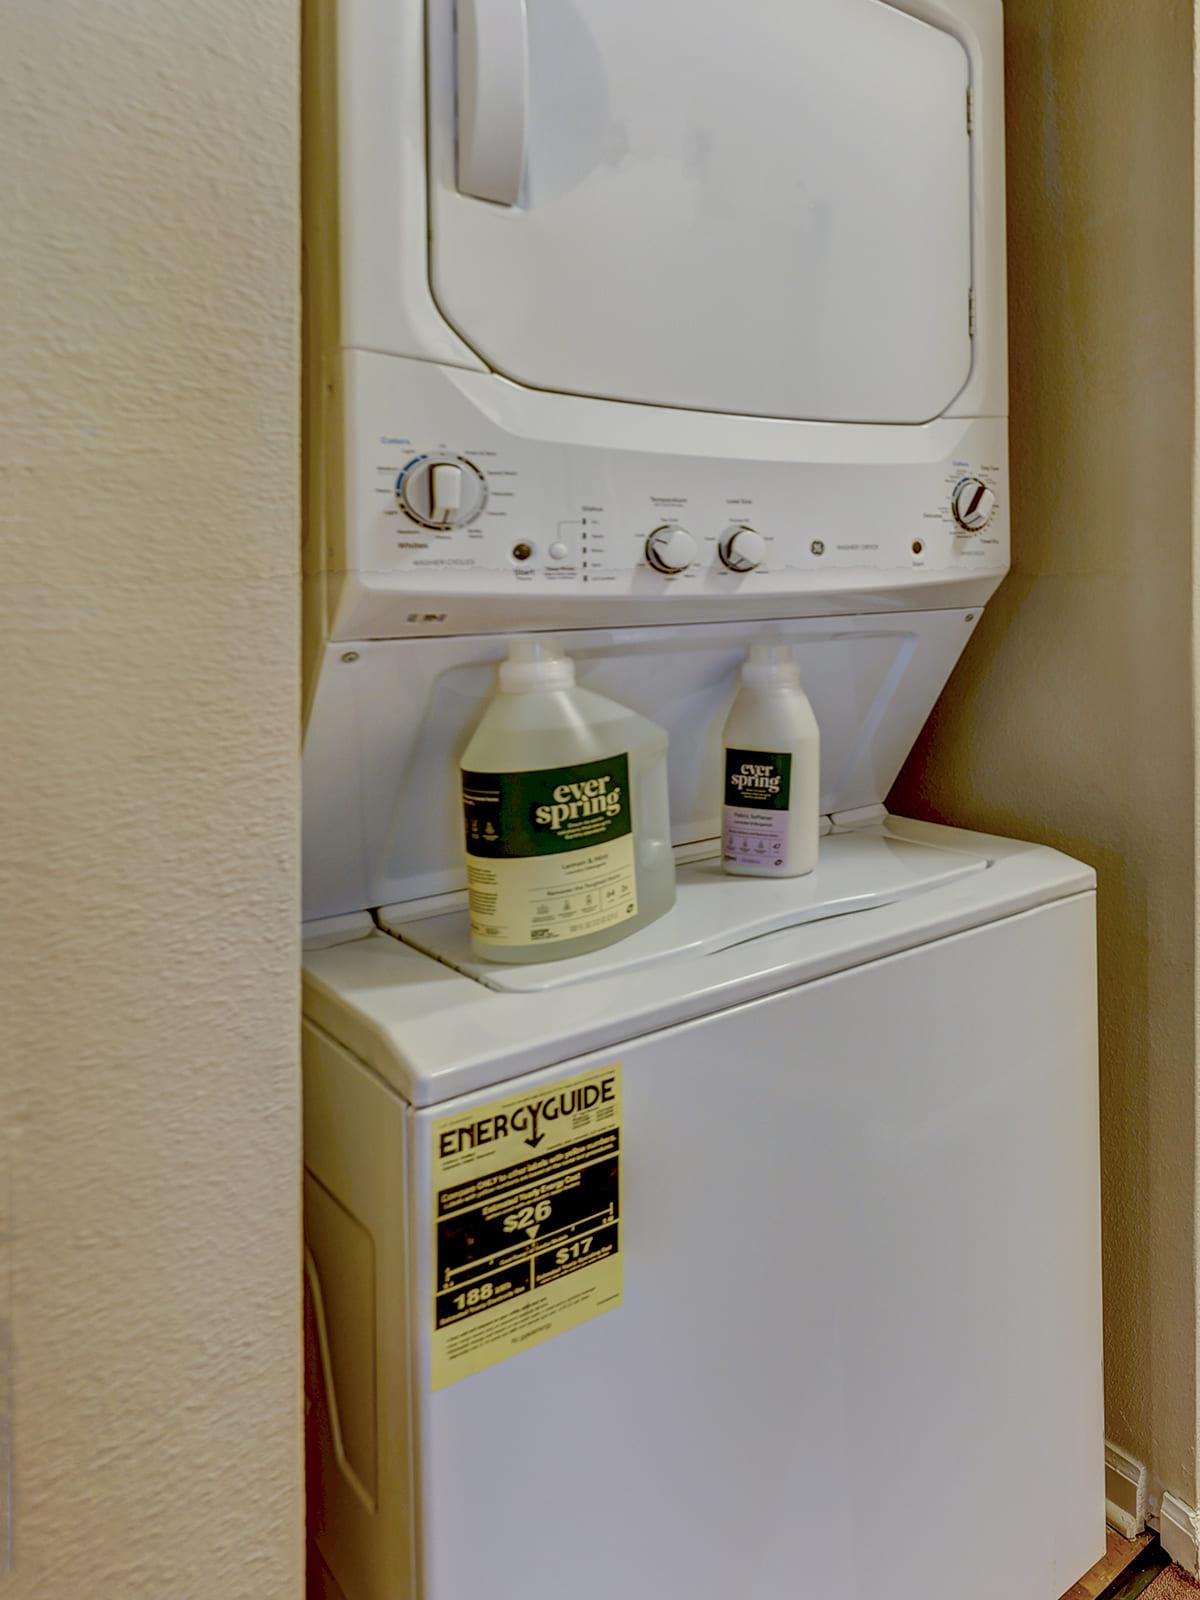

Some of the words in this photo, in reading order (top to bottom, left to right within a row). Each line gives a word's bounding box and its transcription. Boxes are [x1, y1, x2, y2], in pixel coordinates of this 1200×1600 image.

[731, 774, 781, 794] spring
[741, 763, 774, 777] ever
[553, 776, 611, 804] ever
[535, 787, 622, 831] spring
[439, 1077, 616, 1159] ENERGYGUIDE
[503, 1199, 552, 1233] $26
[556, 1236, 594, 1265] $17
[453, 1282, 494, 1310] 188
